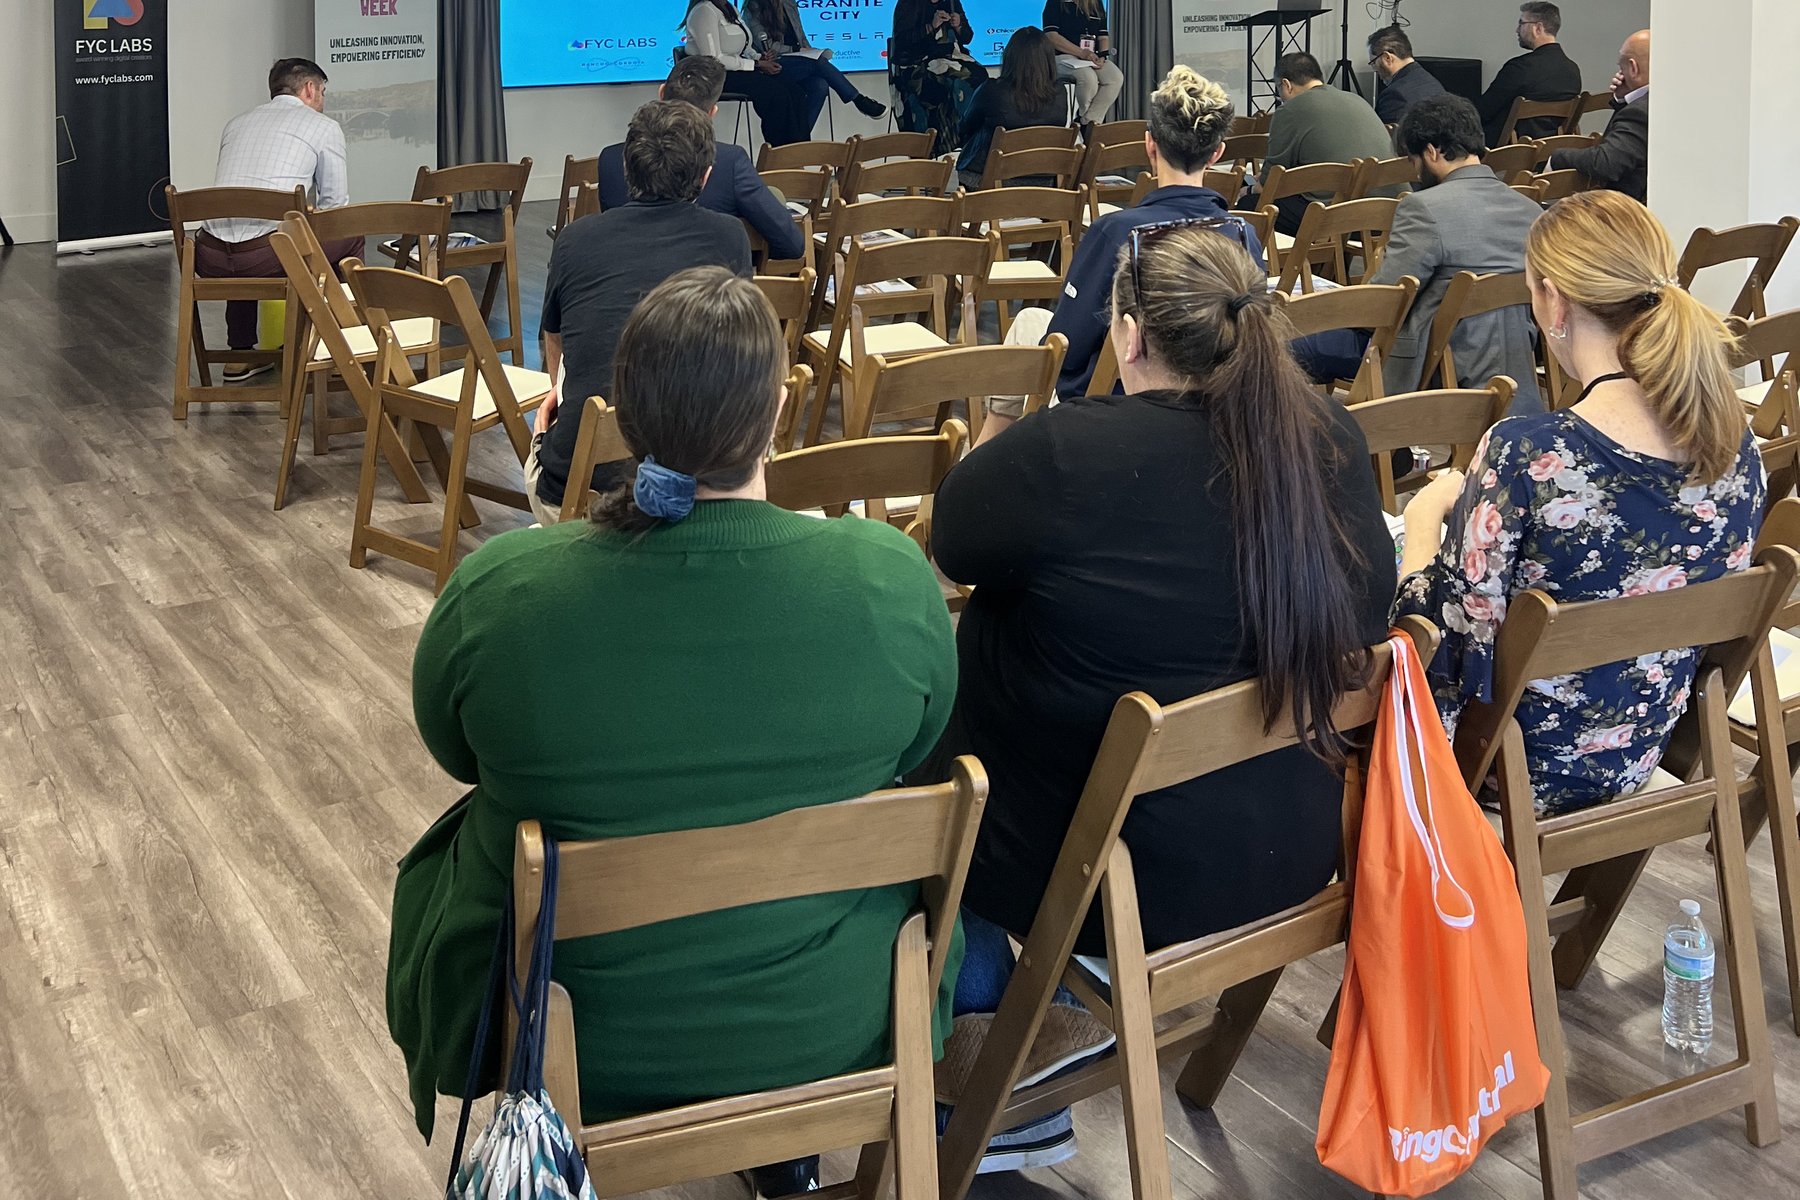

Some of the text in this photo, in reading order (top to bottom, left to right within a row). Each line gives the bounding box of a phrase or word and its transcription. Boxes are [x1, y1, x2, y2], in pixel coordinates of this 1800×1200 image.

[820, 11, 861, 21] CITY
[329, 34, 424, 48] UNLEASHING INNOVATION,
[808, 32, 884, 41] TESLA
[75, 38, 153, 54] FYC LABS
[584, 38, 657, 49] FYC LABS
[330, 49, 426, 63] EMPOWERING EFFICIENCY
[75, 74, 154, 85] www.fyclabs.com
